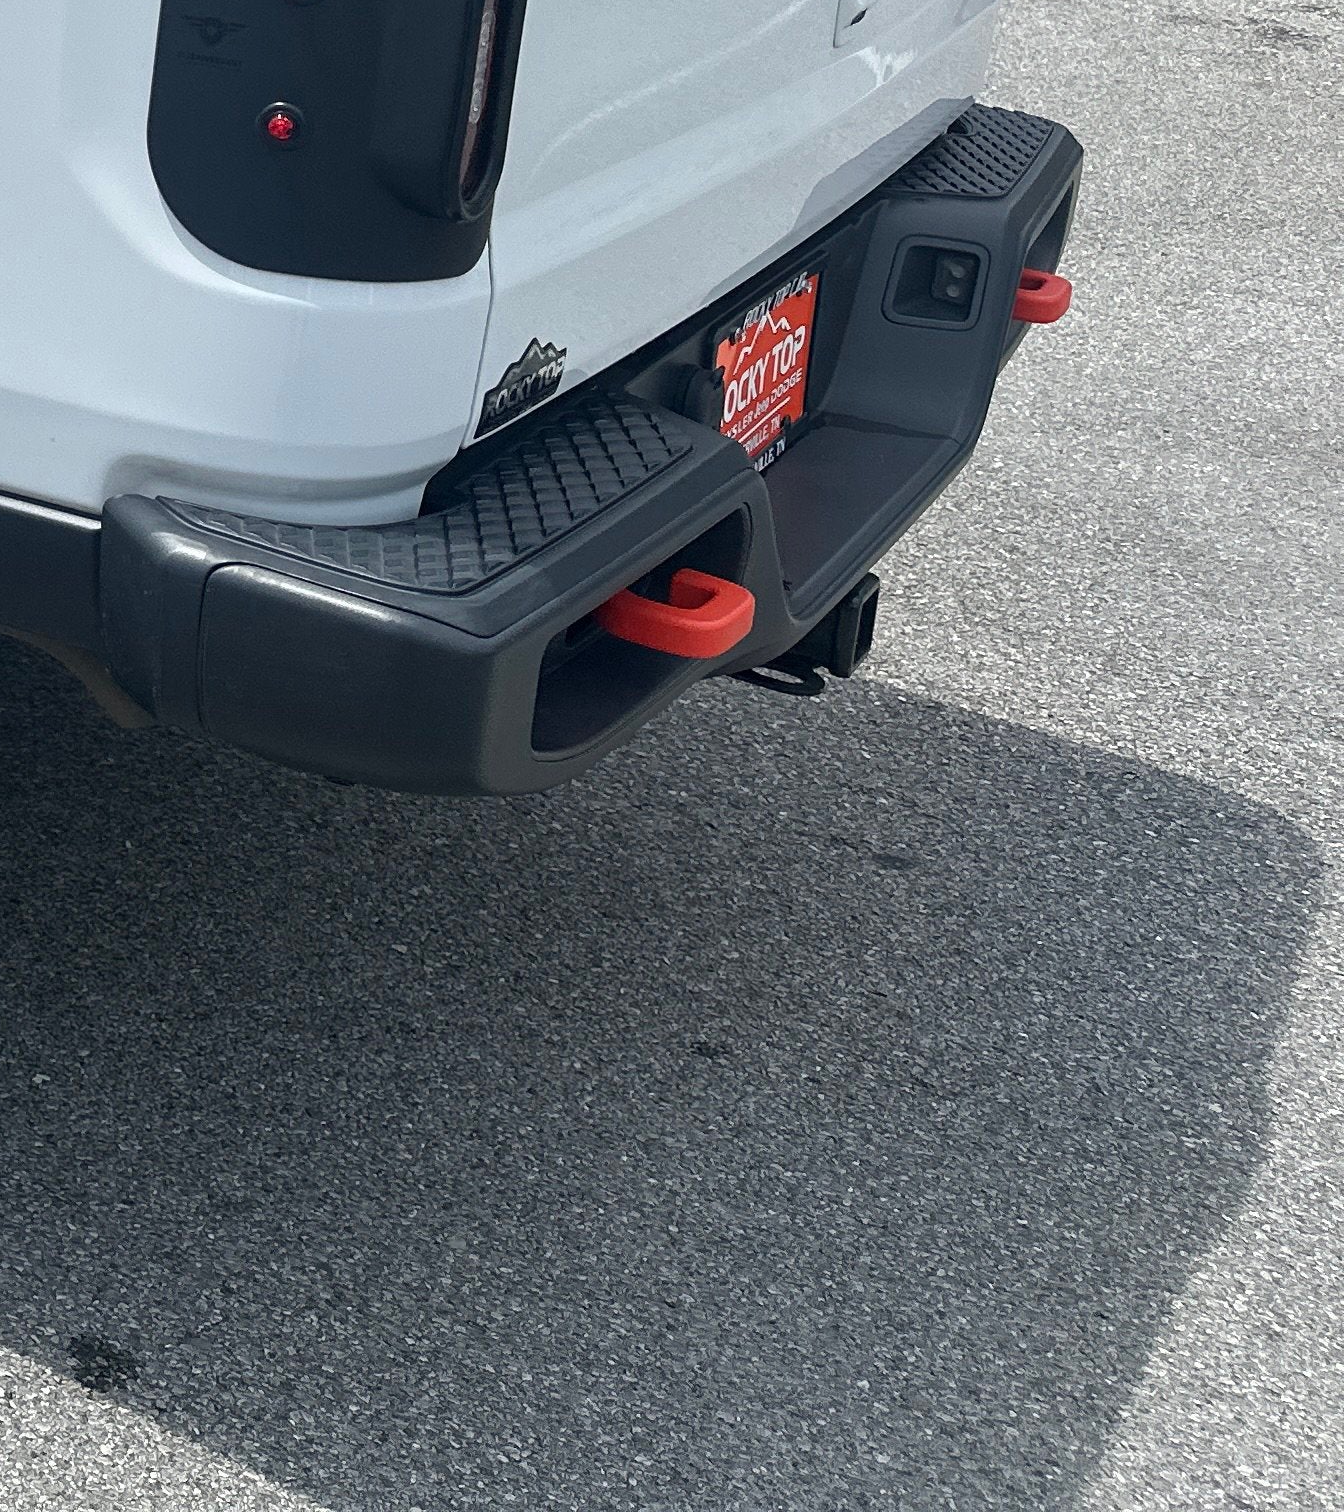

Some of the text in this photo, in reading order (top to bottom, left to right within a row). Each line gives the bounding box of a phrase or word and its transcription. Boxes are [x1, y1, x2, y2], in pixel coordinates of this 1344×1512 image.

[721, 325, 806, 427] OCKY TOP
[770, 367, 803, 404] DODGE
